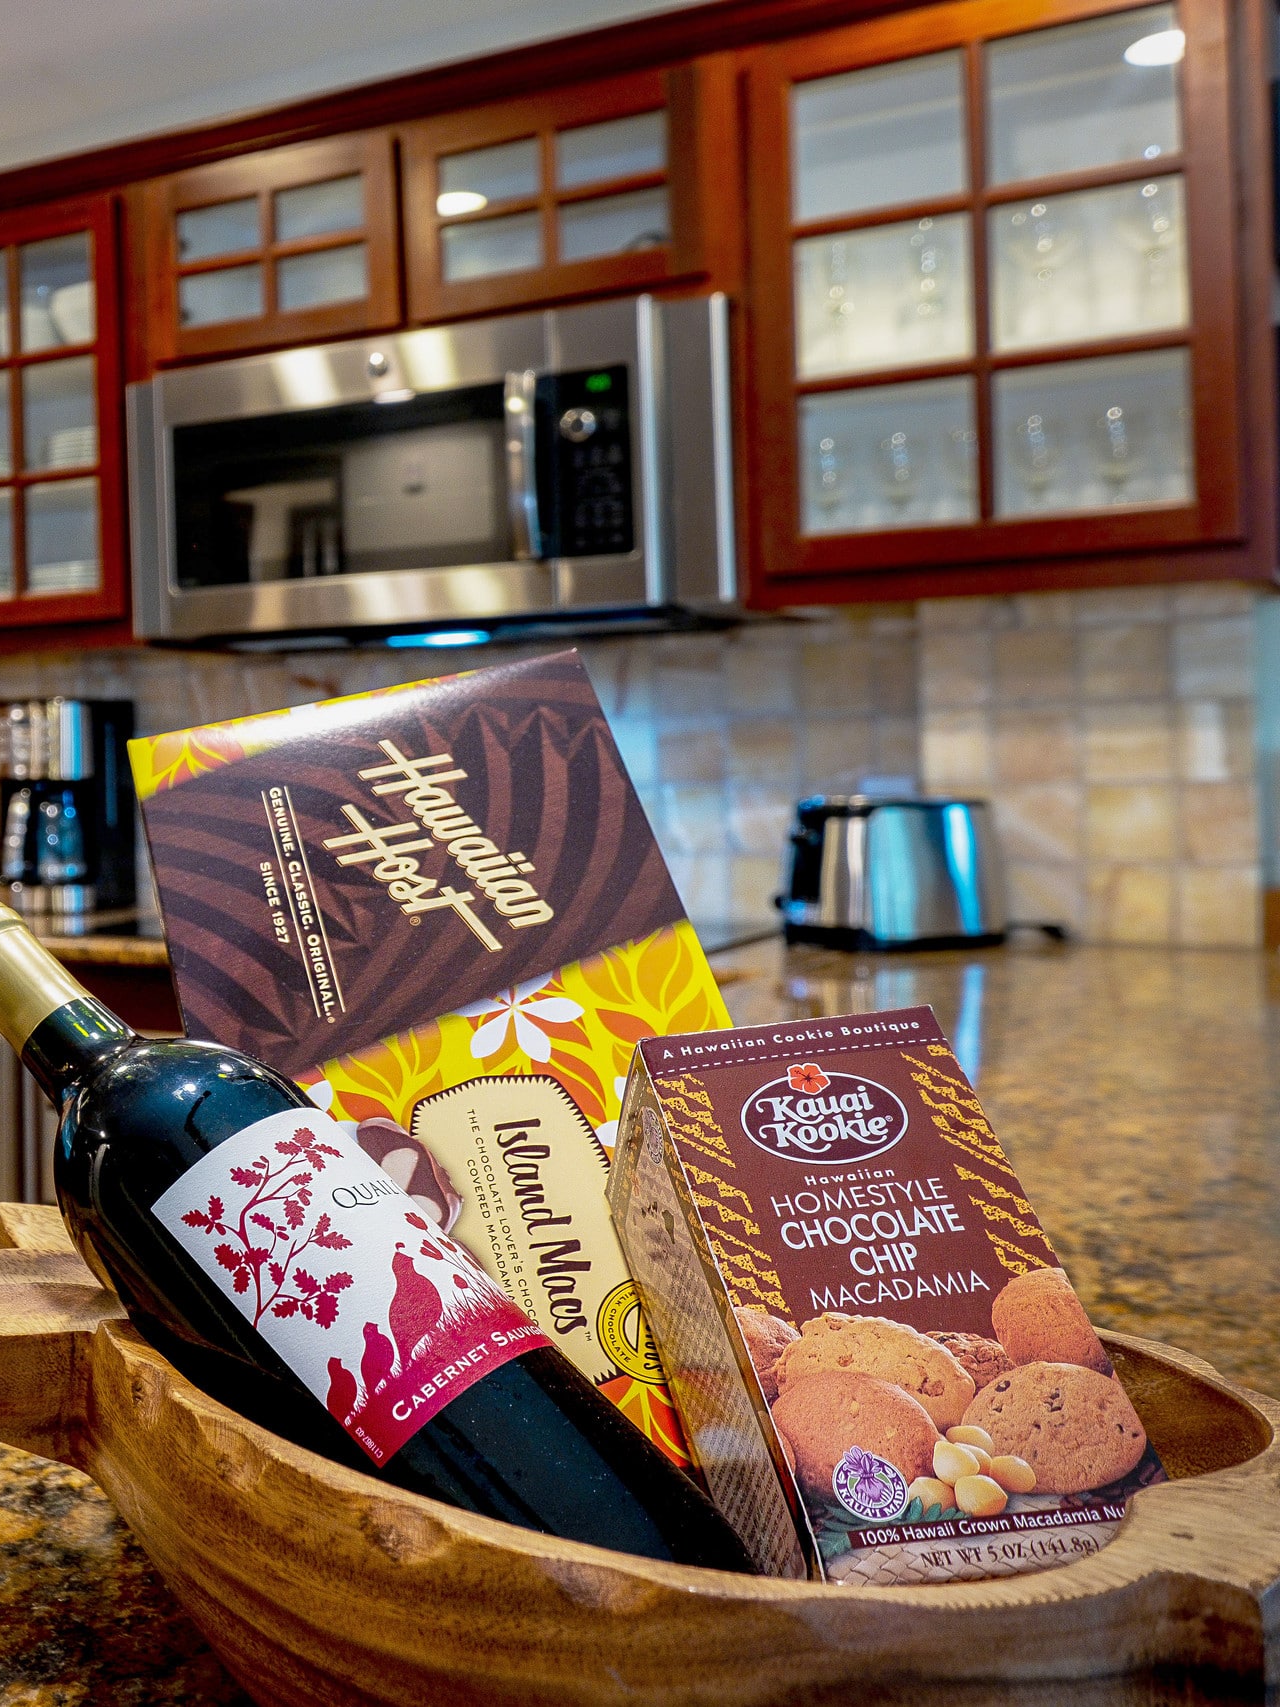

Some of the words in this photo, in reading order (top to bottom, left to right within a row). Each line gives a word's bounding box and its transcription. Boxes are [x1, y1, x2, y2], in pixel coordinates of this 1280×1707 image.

[358, 739, 554, 929] Hawaiian
[269, 787, 296, 857] GENUINE.
[288, 861, 314, 930] CLASSIC.
[322, 804, 503, 952] Host
[260, 861, 281, 907] SINCE
[272, 911, 290, 944] 1927
[663, 1050, 673, 1059] A
[680, 1038, 766, 1057] Hawaiian
[772, 1025, 834, 1044] Cookie
[841, 1020, 920, 1037] Boutique
[755, 1085, 874, 1125] Kauai
[759, 1112, 889, 1153] Kookie
[467, 1159, 491, 1219] COVERED
[467, 1109, 480, 1133] THE
[475, 1137, 505, 1213] CHOCOLATE
[500, 1218, 523, 1274] LOVER'S
[494, 1118, 572, 1236] Island
[770, 1178, 948, 1217] HOMESTYLE
[804, 1168, 895, 1186] Hawaiian
[780, 1204, 965, 1250] CHOCOLATE
[849, 1242, 918, 1275] CHIP
[529, 1239, 592, 1335] Macs
[615, 1289, 636, 1306] MILK
[810, 1269, 990, 1310] MACADAMIA
[608, 1308, 631, 1363] CHOCOLATE
[392, 1343, 490, 1421] CABERNET
[883, 1481, 904, 1516] MADE
[858, 1528, 900, 1547] 100%
[902, 1521, 956, 1541] Hawaii
[958, 1516, 1011, 1536] Grown
[1012, 1506, 1102, 1529] Macadamia
[920, 1549, 951, 1568] NET
[955, 1547, 983, 1565] WT
[1002, 1543, 1027, 1560] OZ
